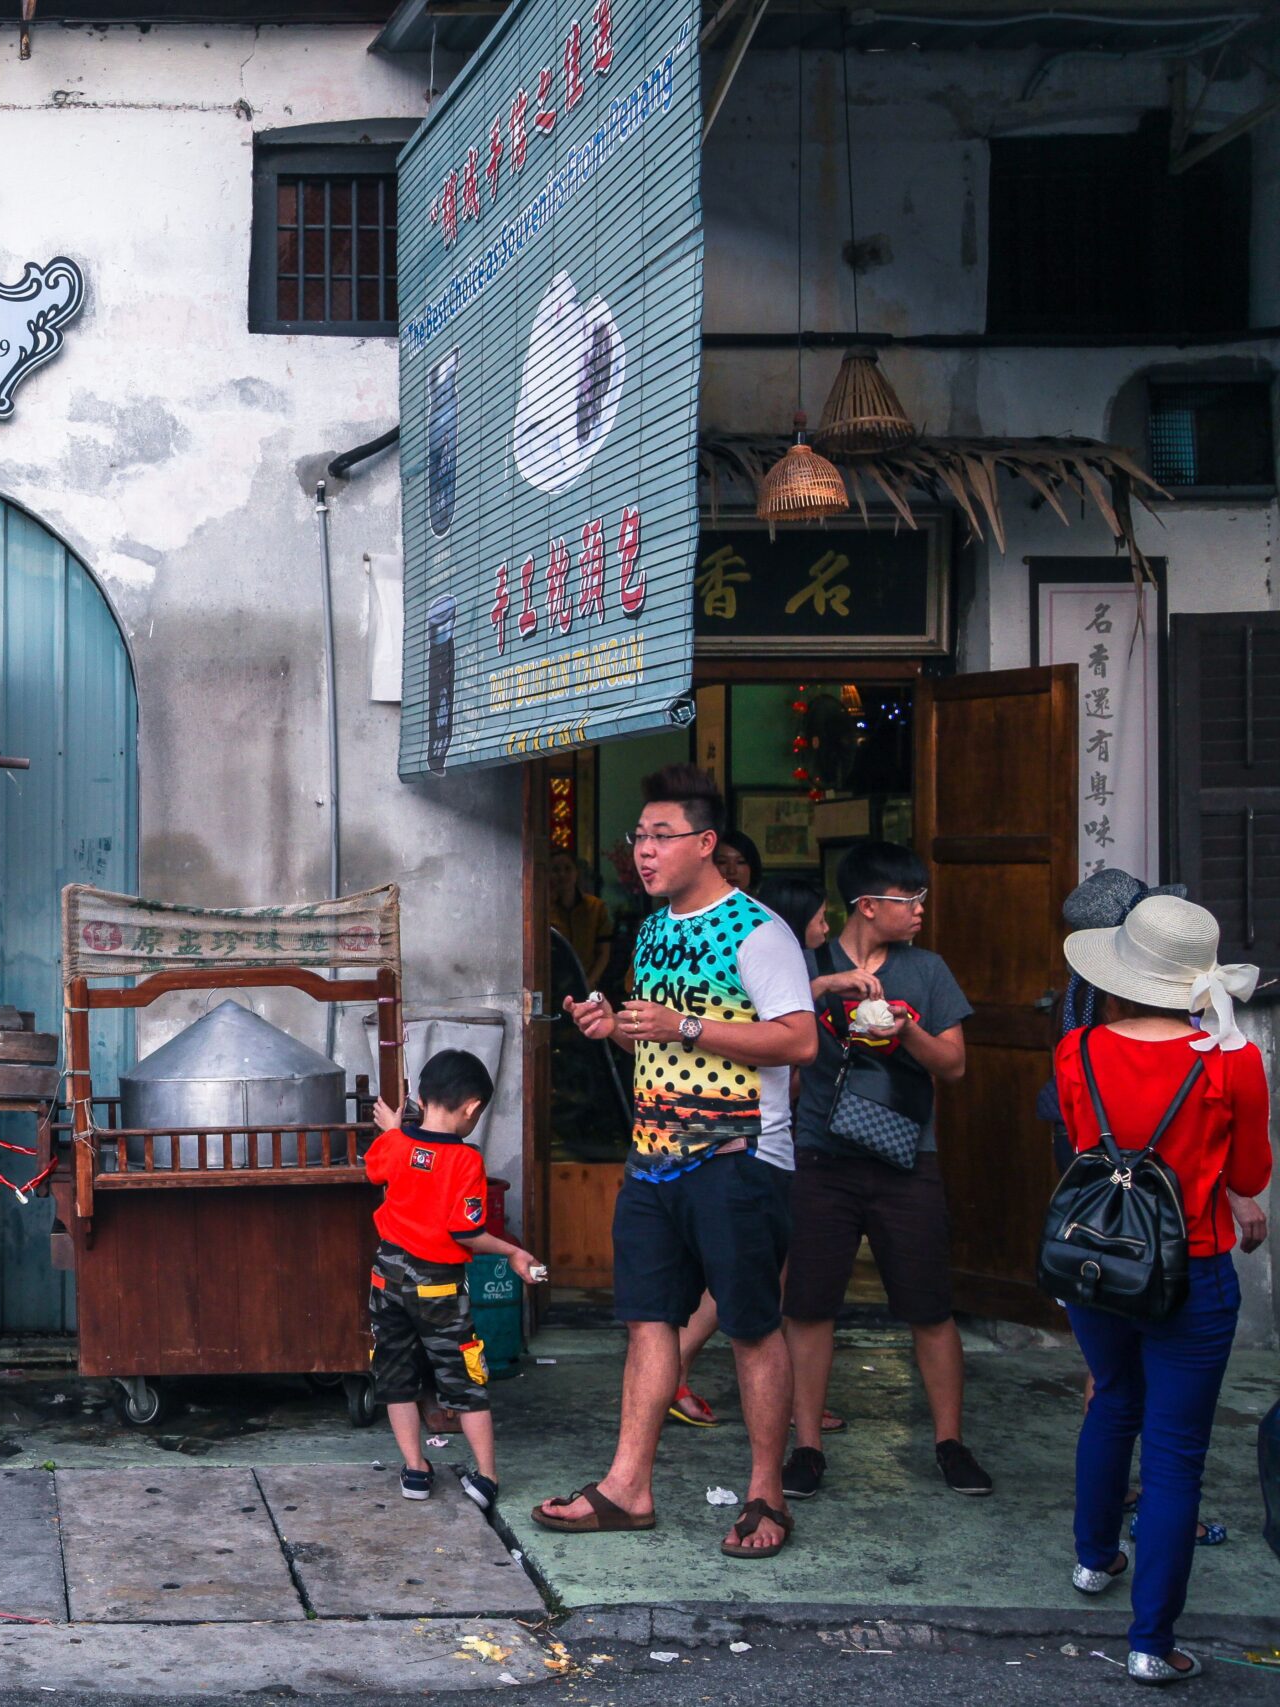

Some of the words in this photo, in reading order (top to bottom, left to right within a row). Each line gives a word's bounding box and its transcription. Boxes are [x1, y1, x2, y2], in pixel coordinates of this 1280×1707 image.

[426, 289, 448, 342] Best
[450, 257, 484, 319] Choice
[487, 242, 499, 283] as
[501, 169, 564, 270] Souvenirs
[567, 121, 607, 200] From
[694, 545, 851, 619] 名香
[572, 632, 645, 695] TANGAN
[484, 1280, 513, 1293] GAS
